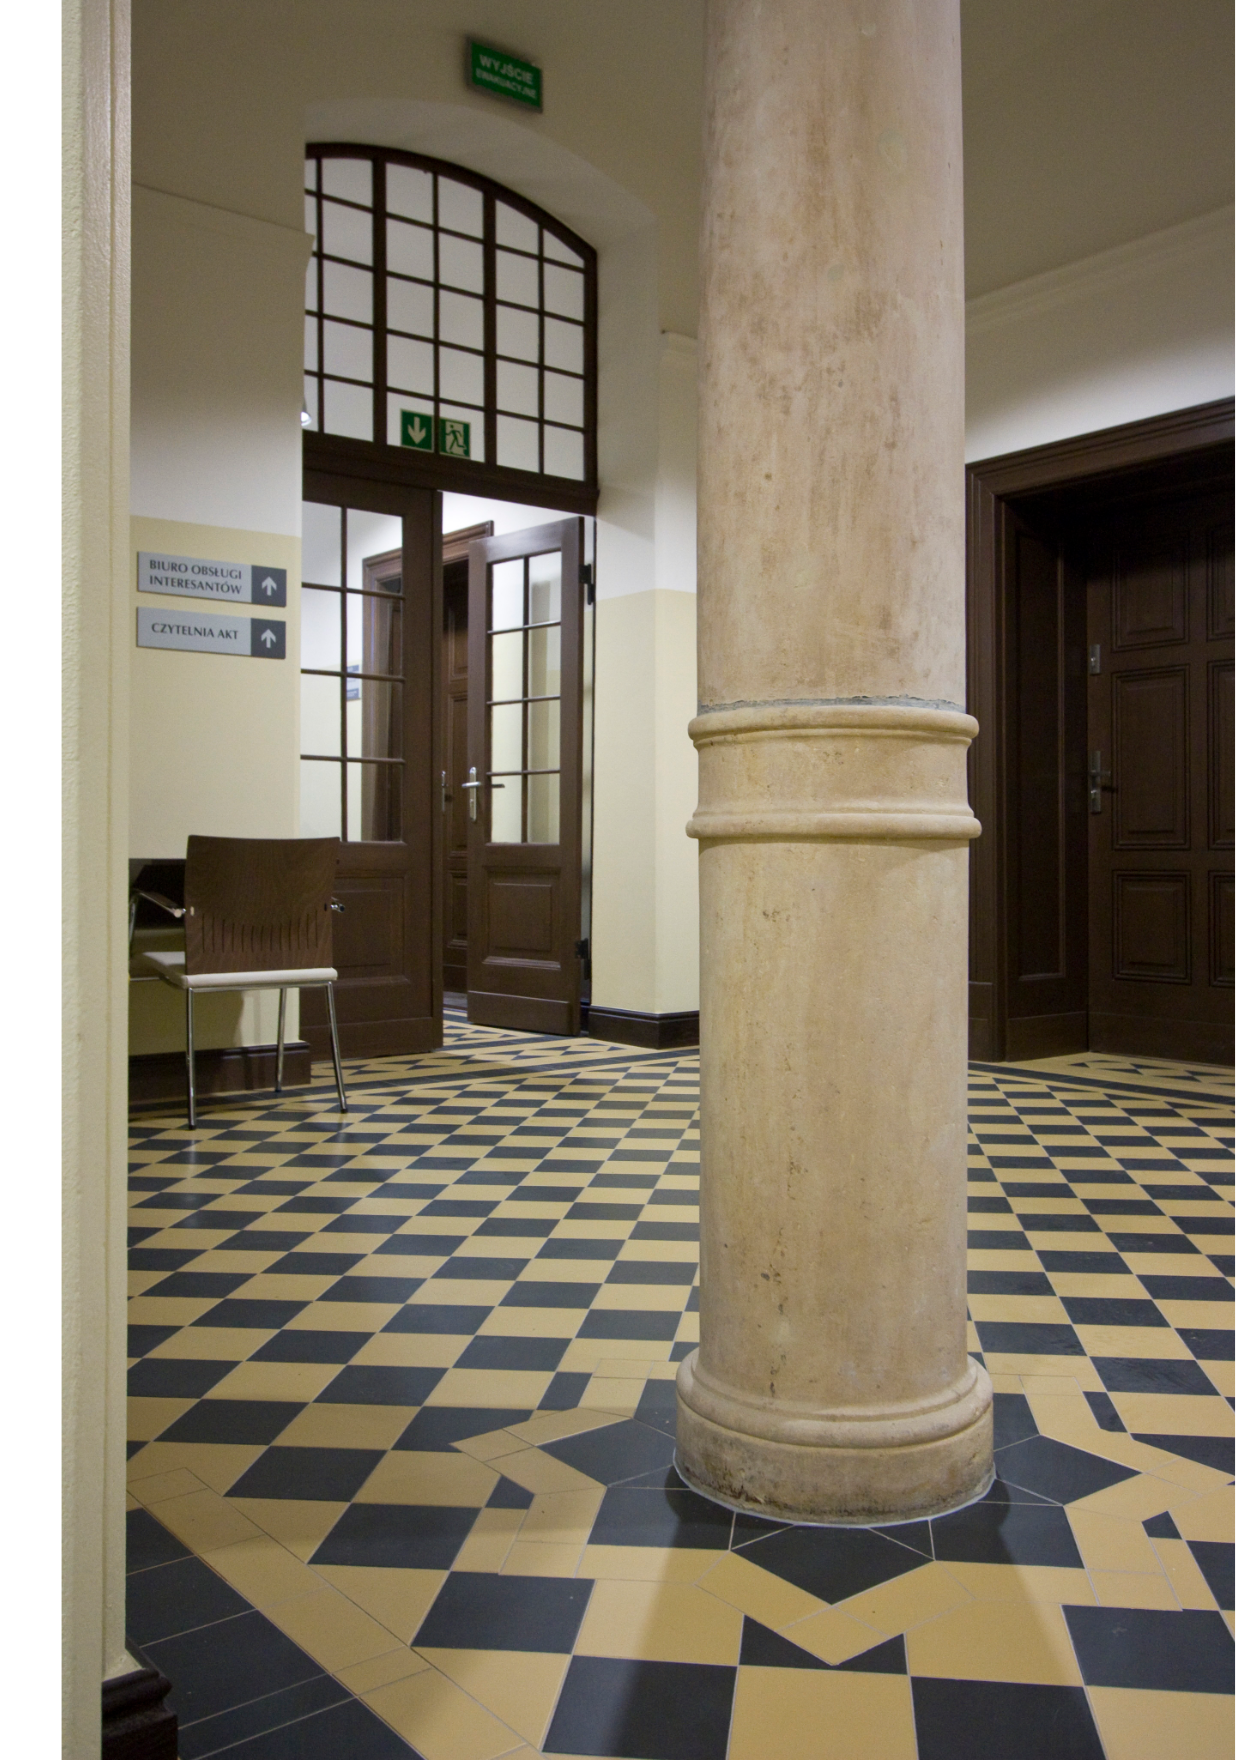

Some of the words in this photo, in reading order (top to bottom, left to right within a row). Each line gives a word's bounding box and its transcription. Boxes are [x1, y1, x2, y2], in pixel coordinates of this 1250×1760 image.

[149, 559, 188, 574] BIURO
[191, 564, 242, 580] OBSŁUGI
[149, 575, 242, 595] INTERESANTÓW
[151, 622, 215, 639] CZYTELNIA
[217, 630, 239, 640] AKT
